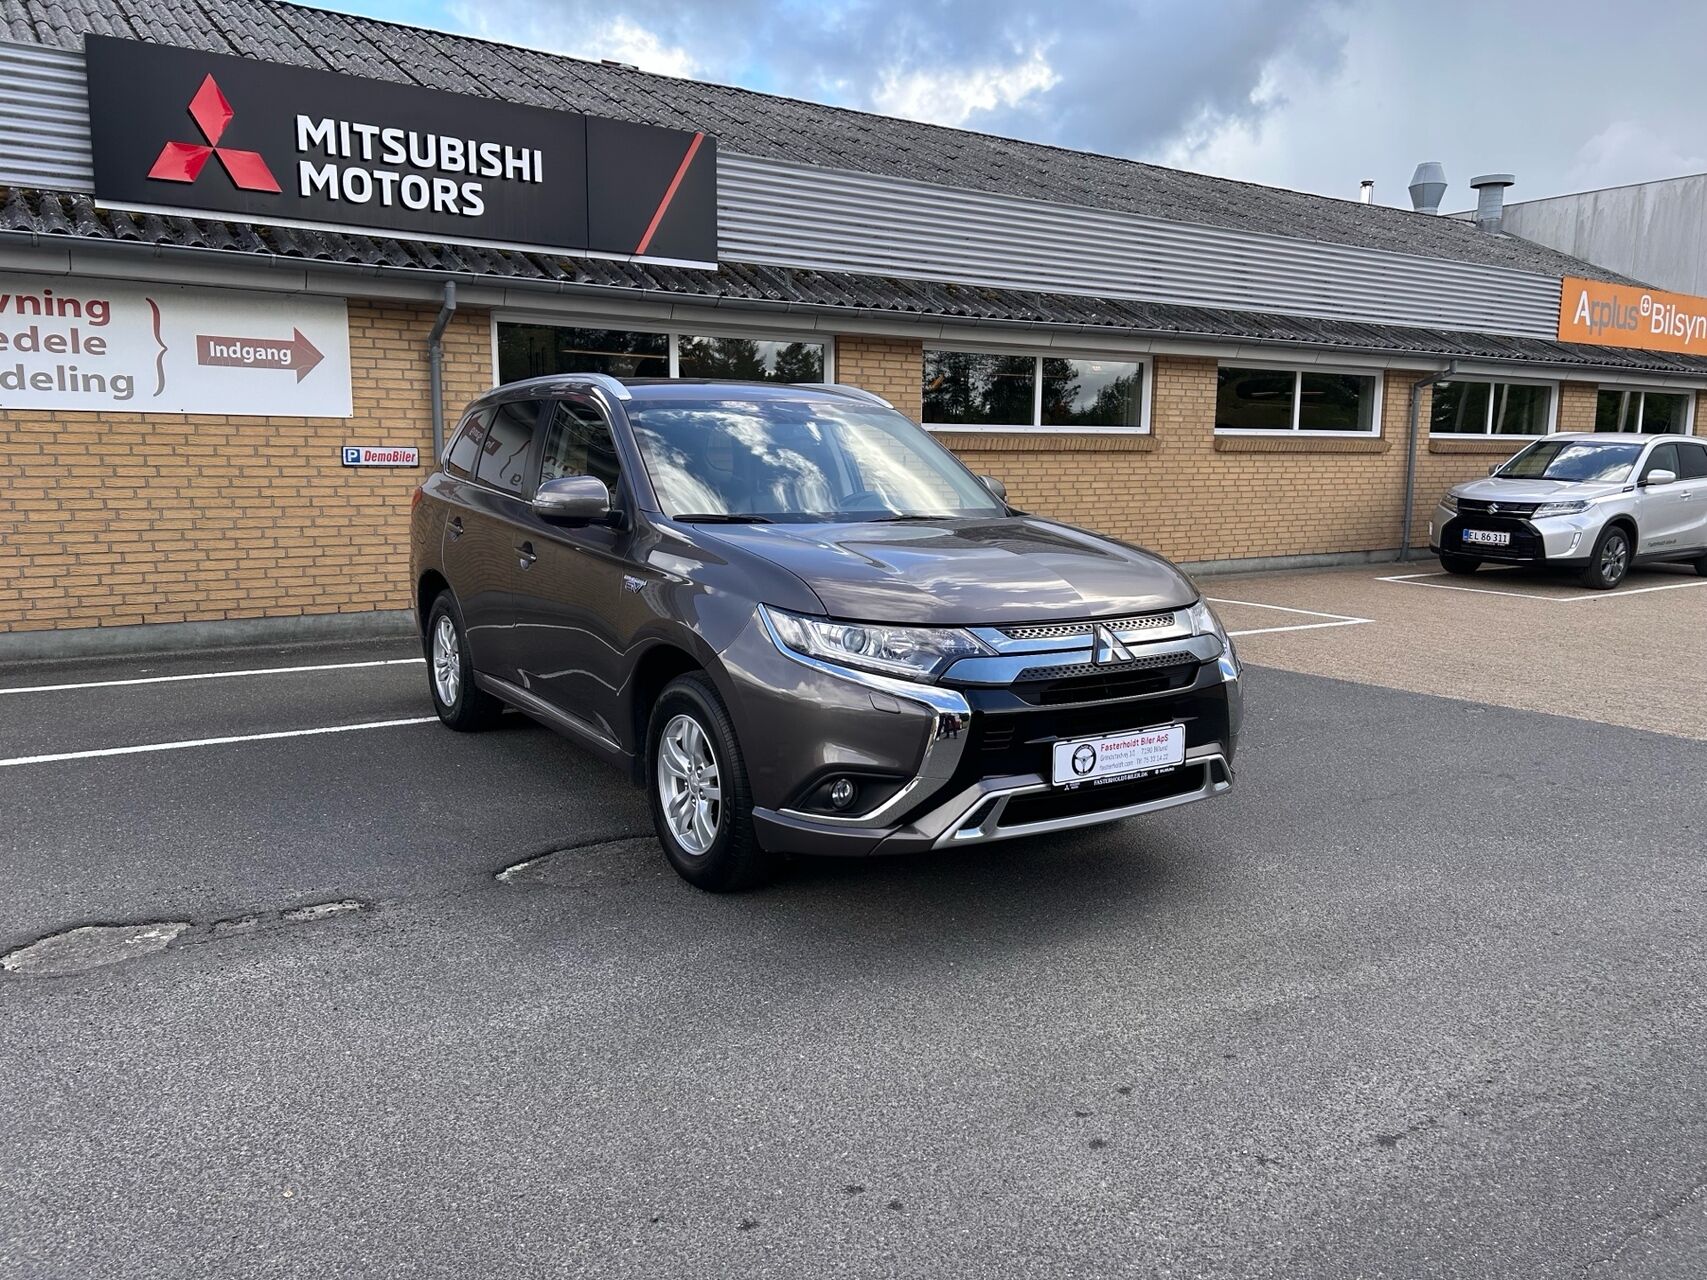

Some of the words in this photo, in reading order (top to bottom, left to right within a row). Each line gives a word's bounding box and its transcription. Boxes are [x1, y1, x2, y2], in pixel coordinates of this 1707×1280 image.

[296, 114, 543, 183] MITSUBISHI
[299, 160, 485, 216] MOTORS
[1650, 302, 1707, 345] Bilsyn
[209, 341, 292, 365] Indgang
[347, 449, 359, 462] P
[364, 450, 416, 463] DemoBiler
[1468, 531, 1479, 541] EL
[1481, 532, 1491, 542] 86
[1493, 533, 1507, 543] 311
[1100, 739, 1139, 752] Fasterholdt
[1141, 736, 1154, 746] Biler
[1156, 733, 1169, 744] ApS
